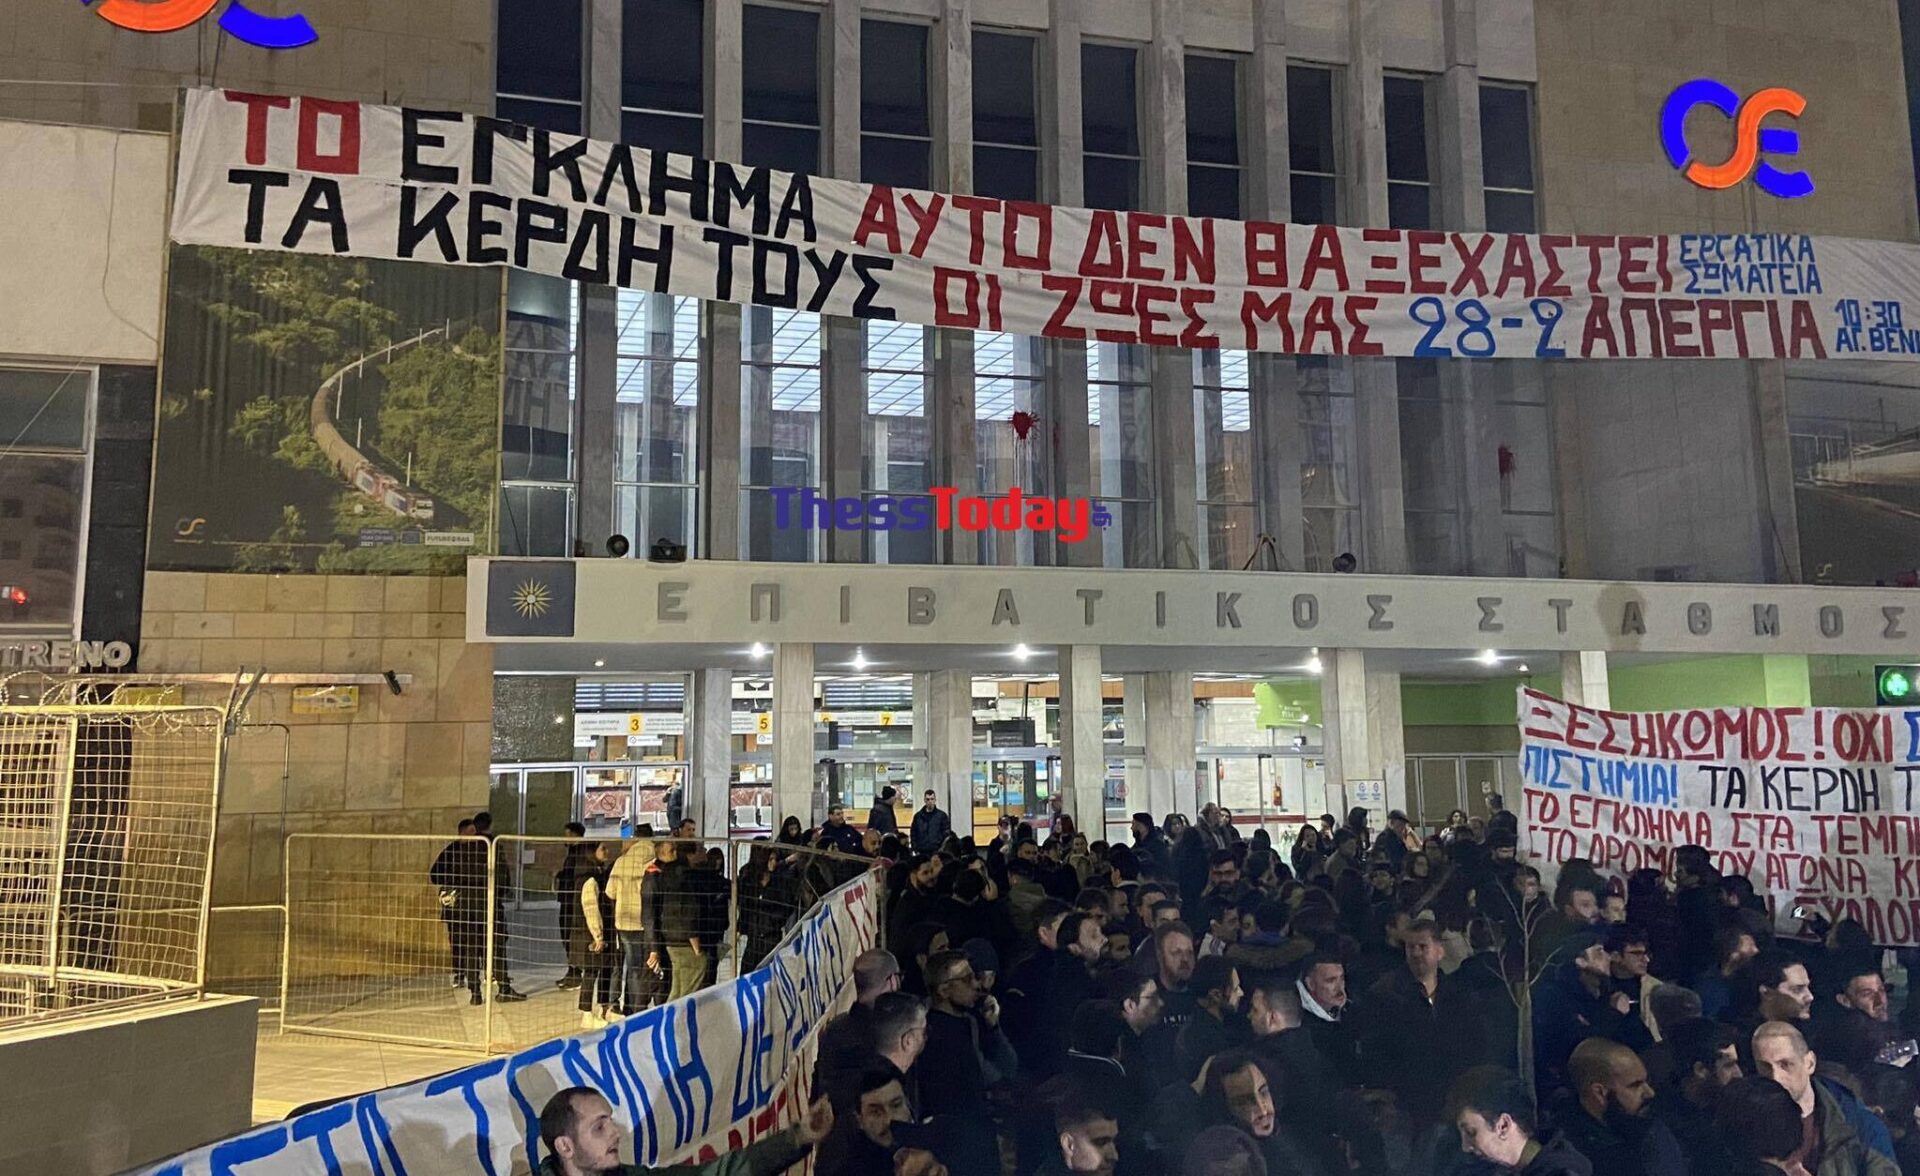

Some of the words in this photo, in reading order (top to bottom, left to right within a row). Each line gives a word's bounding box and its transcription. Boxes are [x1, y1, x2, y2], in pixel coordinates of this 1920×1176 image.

[224, 90, 360, 175] ΤΟ
[401, 106, 817, 243] ΕΓΚΛΗΜΑ
[853, 183, 1053, 272] ΑΥΤΟ
[1078, 209, 1216, 285] ΔΕΝ
[1245, 221, 1349, 292] ΘΑ
[1363, 228, 1673, 298] ΞΕΧΑΣΤΕΙ
[228, 168, 350, 253] ΤΑ
[397, 184, 674, 294] ΚΕΡΔΗ
[703, 226, 898, 321] ΤΟΥΣ
[933, 265, 1003, 333] ΟΙ
[1041, 272, 1221, 349] ΖΩΕΣ
[1241, 290, 1384, 356] ΜΑΣ
[1408, 296, 1567, 358] 28-2
[1580, 297, 1828, 360] ΑΠΕΡΓΙΑ
[1678, 233, 1816, 264] ΕΡΓΑΤΙΚΑ
[1683, 262, 1824, 295] ΣΩΜΑΤΕΙΑ
[1834, 298, 1903, 328] 10:30
[656, 580, 1395, 631] ΕΠΙΒΑΤΙΚΟΣ
[1476, 596, 1908, 640] ΣΤΑΘΜΟΣ
[631, 719, 640, 731] 3
[760, 718, 768, 730] 5
[1832, 712, 1894, 763] ΟΧΙ
[1524, 744, 1678, 808] ΠΙΣΤΗΜΙΑ!
[1699, 765, 1747, 808] ΤΑ
[1760, 765, 1880, 813] ΚΕΡΔΗ
[1523, 788, 1560, 823] ΤΟ
[1570, 793, 1713, 848] ΕΓΚΛΗΜΑ
[1731, 812, 1795, 851] ΣΤΑ
[1528, 824, 1578, 865] ΣΤΟ
[1708, 849, 1756, 878] ΟΥ
[1765, 852, 1868, 896] ΑΓΩΝΑ
